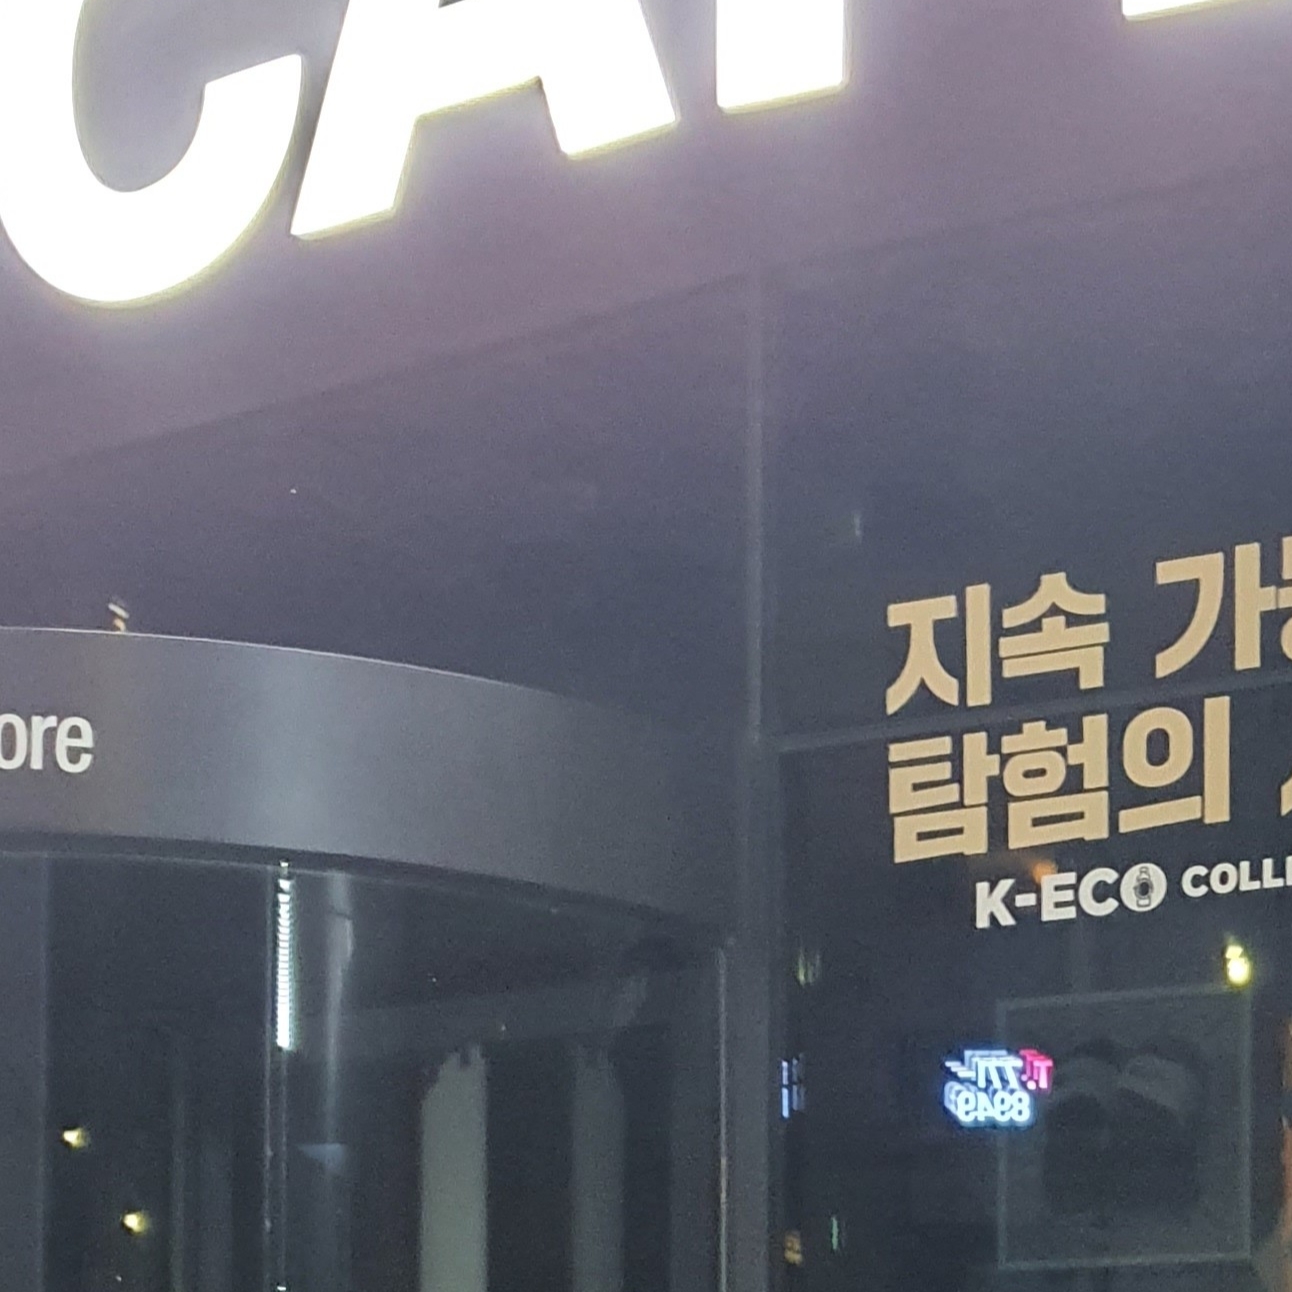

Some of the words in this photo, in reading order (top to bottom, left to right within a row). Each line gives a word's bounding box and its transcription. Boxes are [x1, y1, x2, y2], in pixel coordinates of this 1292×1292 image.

[886, 572, 1110, 714] 지속
[888, 695, 1231, 864] 탐험의
[975, 862, 1168, 929] K-ECO
